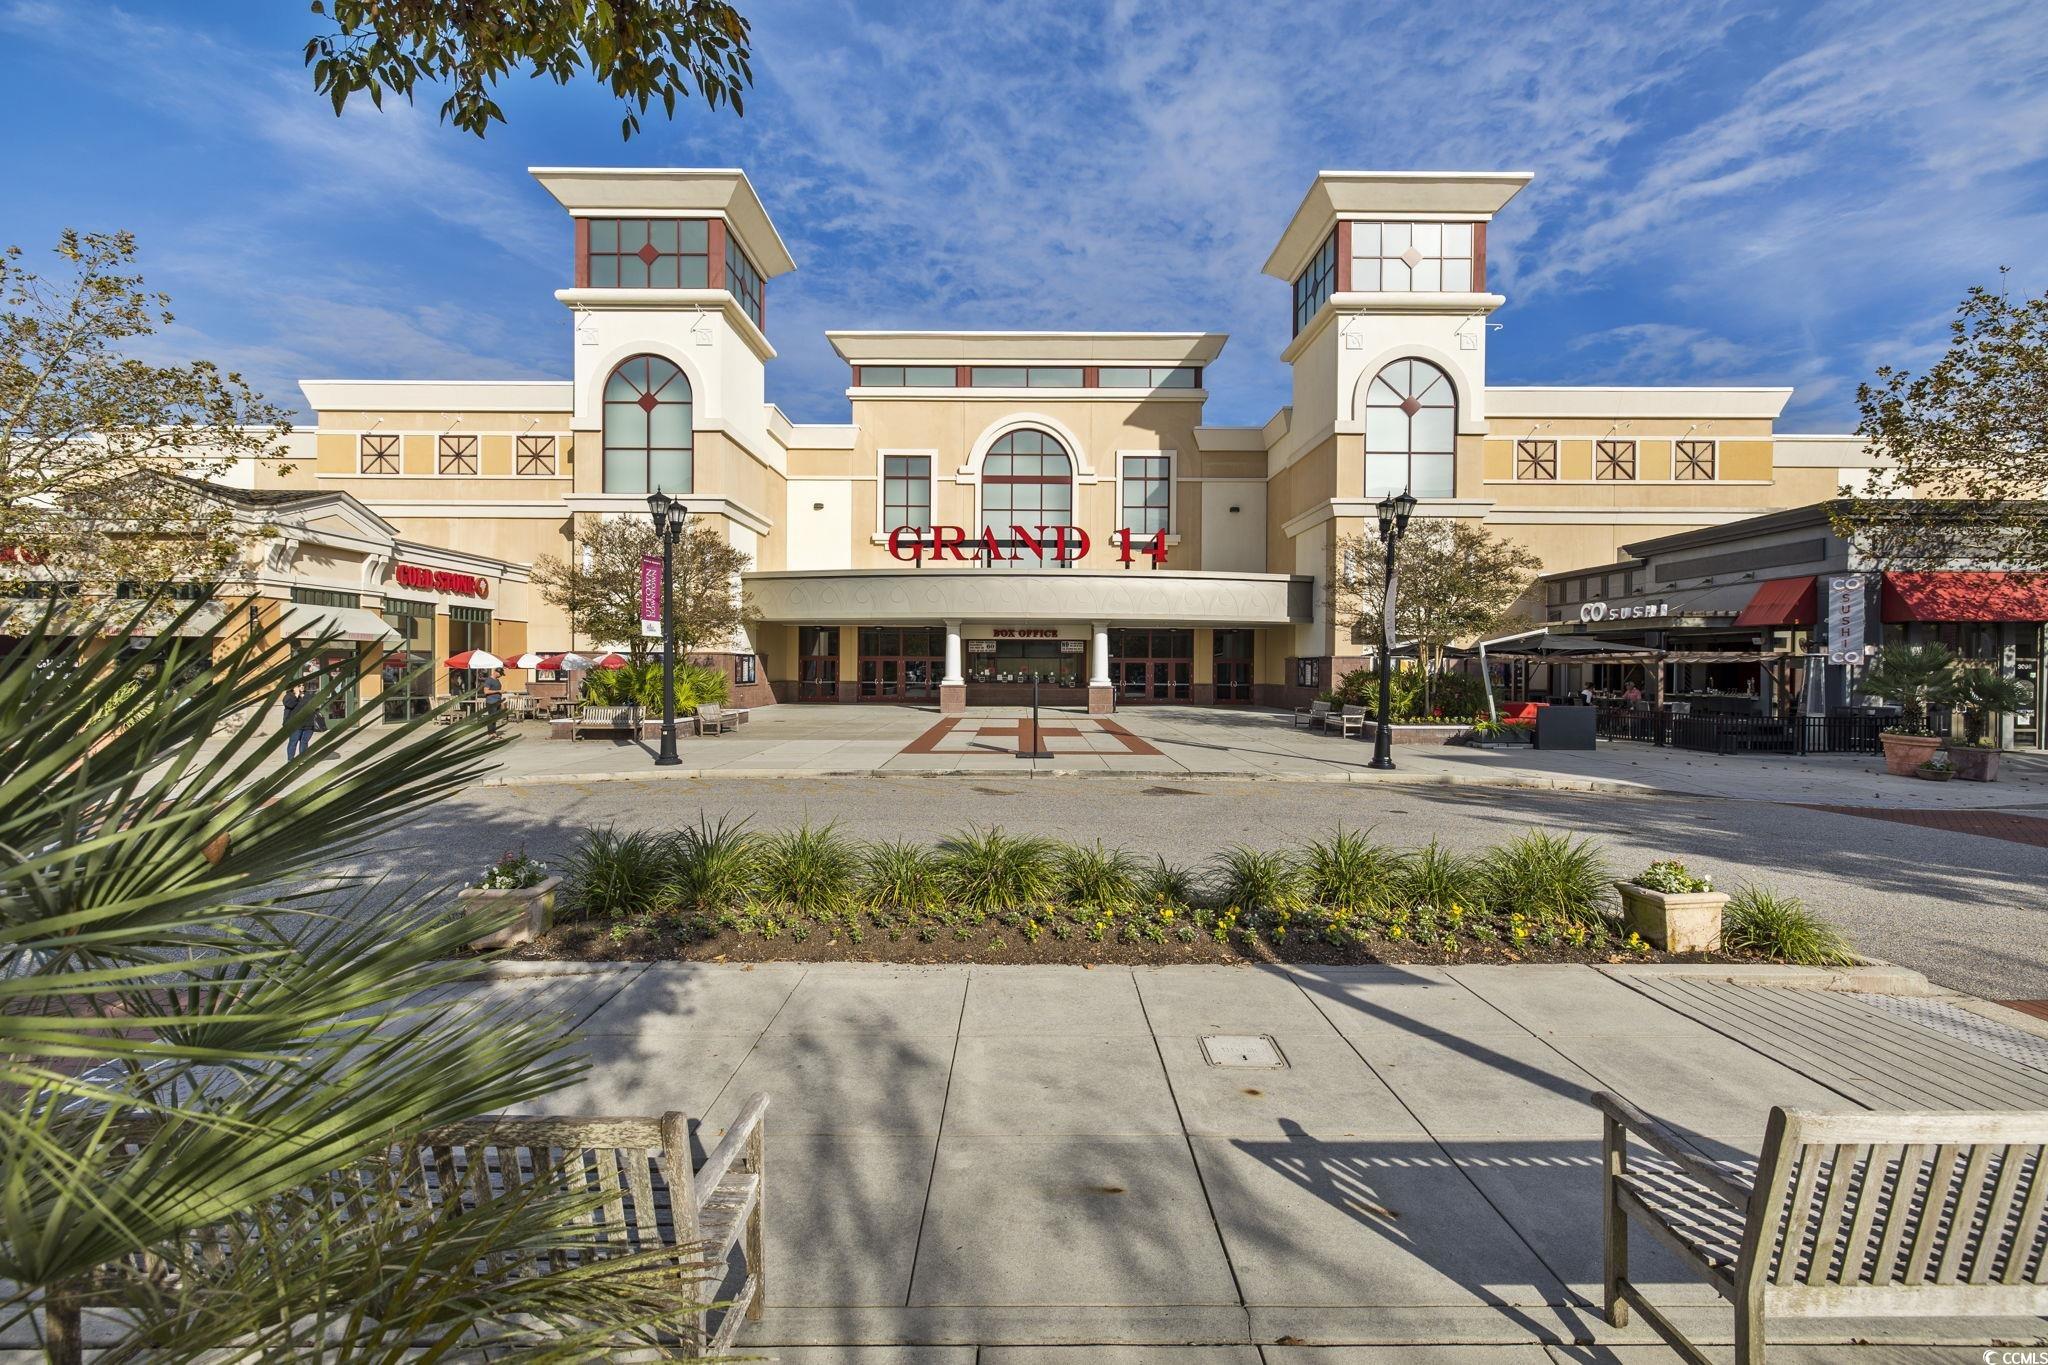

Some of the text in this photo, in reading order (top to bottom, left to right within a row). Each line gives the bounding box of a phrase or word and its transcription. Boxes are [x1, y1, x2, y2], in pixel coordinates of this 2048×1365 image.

[888, 525, 1168, 563] GRAND 14
[396, 564, 475, 595] COLD STONE
[1833, 579, 1860, 590] CO
[1580, 602, 1668, 622] CO SUSHI
[1841, 593, 1850, 648] SUSHI
[993, 629, 1058, 638] BOX OFFICE
[1831, 651, 1860, 663] CO
